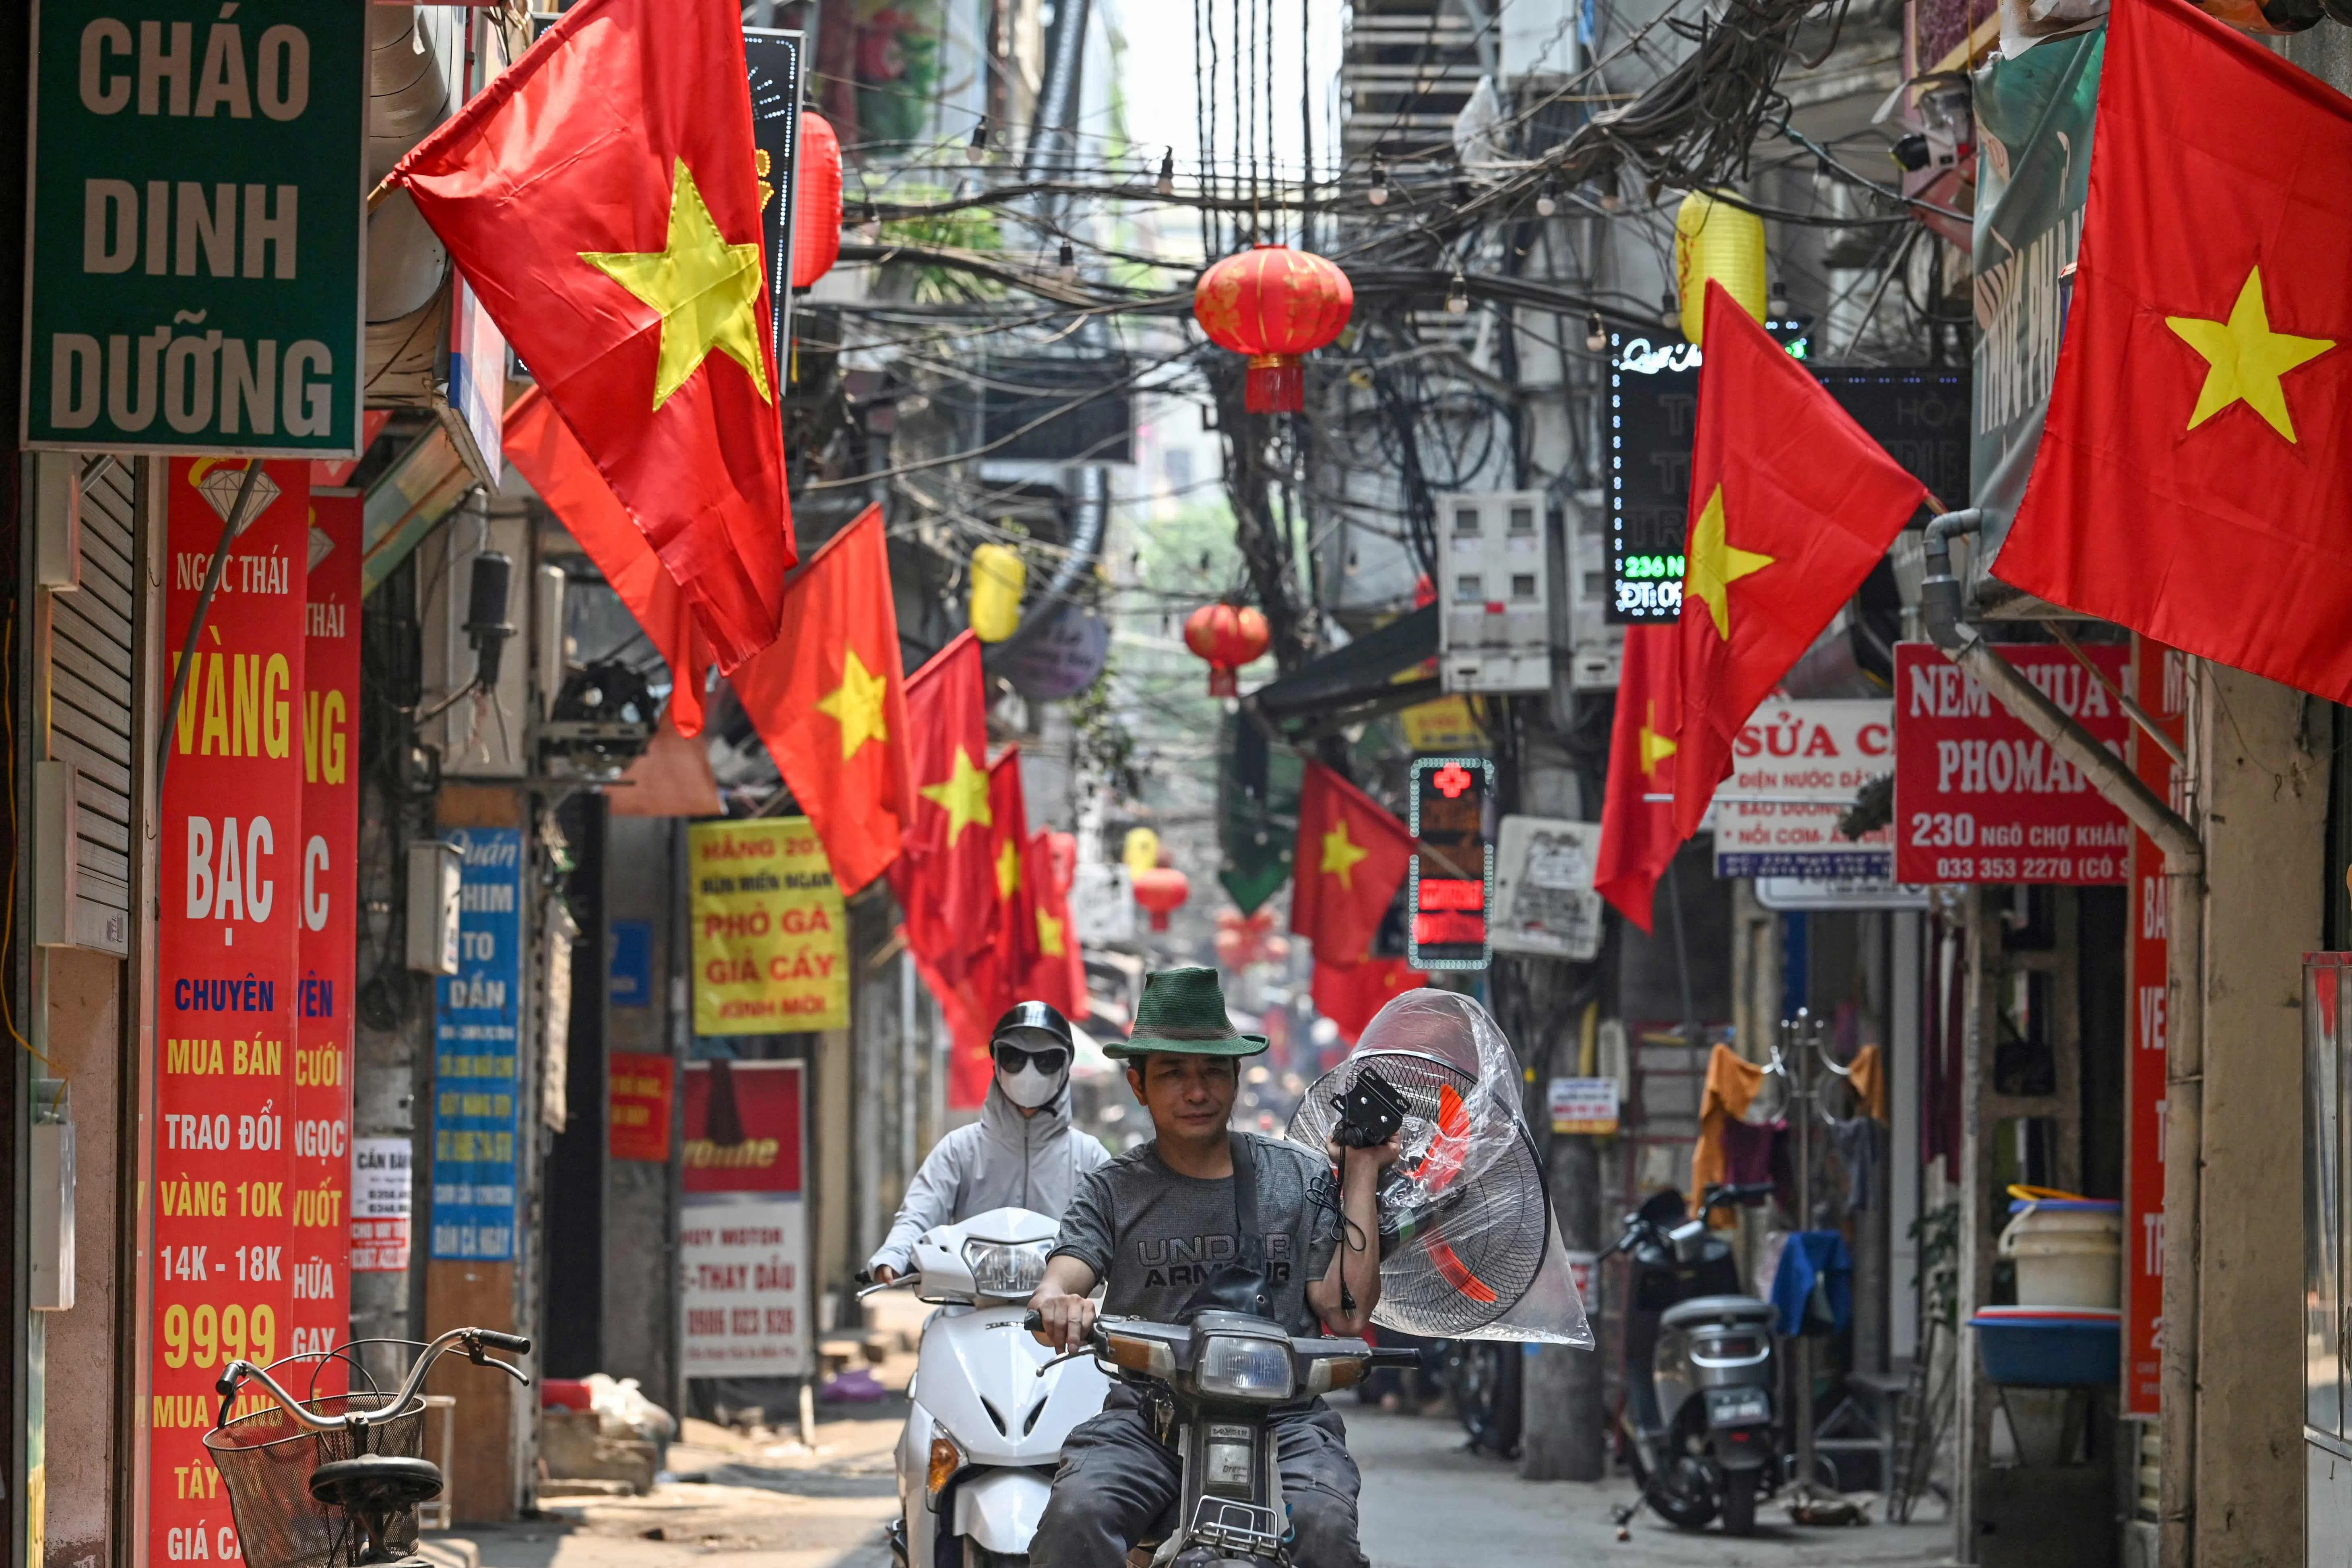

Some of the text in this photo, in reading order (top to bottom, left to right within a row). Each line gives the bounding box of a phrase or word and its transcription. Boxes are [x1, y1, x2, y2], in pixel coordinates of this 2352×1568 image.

[79, 2, 310, 121] CHÁO
[83, 178, 298, 279] DINH
[51, 309, 332, 437] DƯỠNG
[239, 544, 289, 595] THÁI
[1625, 555, 1665, 578] 236
[173, 625, 289, 759] VÀNG
[1909, 664, 1991, 718] NEM
[2004, 664, 2110, 718] HUA
[1735, 710, 1895, 757] SỬA C
[1911, 812, 1975, 847] 230
[1980, 822, 2023, 847] NGÕ
[2029, 824, 2071, 851] CHỢ
[187, 816, 274, 946] BẠC
[298, 835, 330, 932] C
[1937, 857, 1974, 879] 033
[1979, 857, 2016, 878] 353
[2022, 857, 2072, 879] 2270
[462, 931, 495, 961] TO
[175, 973, 274, 1011] CHUYÊN
[167, 1031, 281, 1076] MUA BÁN
[165, 1099, 281, 1151] TRAO ĐỔI
[161, 1172, 283, 1217] VÀNG 10K
[161, 1246, 207, 1281] 14K
[235, 1246, 282, 1281] 18K
[1138, 1233, 1291, 1267] UNDR
[164, 1304, 275, 1369] 9999
[154, 1395, 209, 1428] MUA
[167, 1519, 209, 1561] GIÁ
